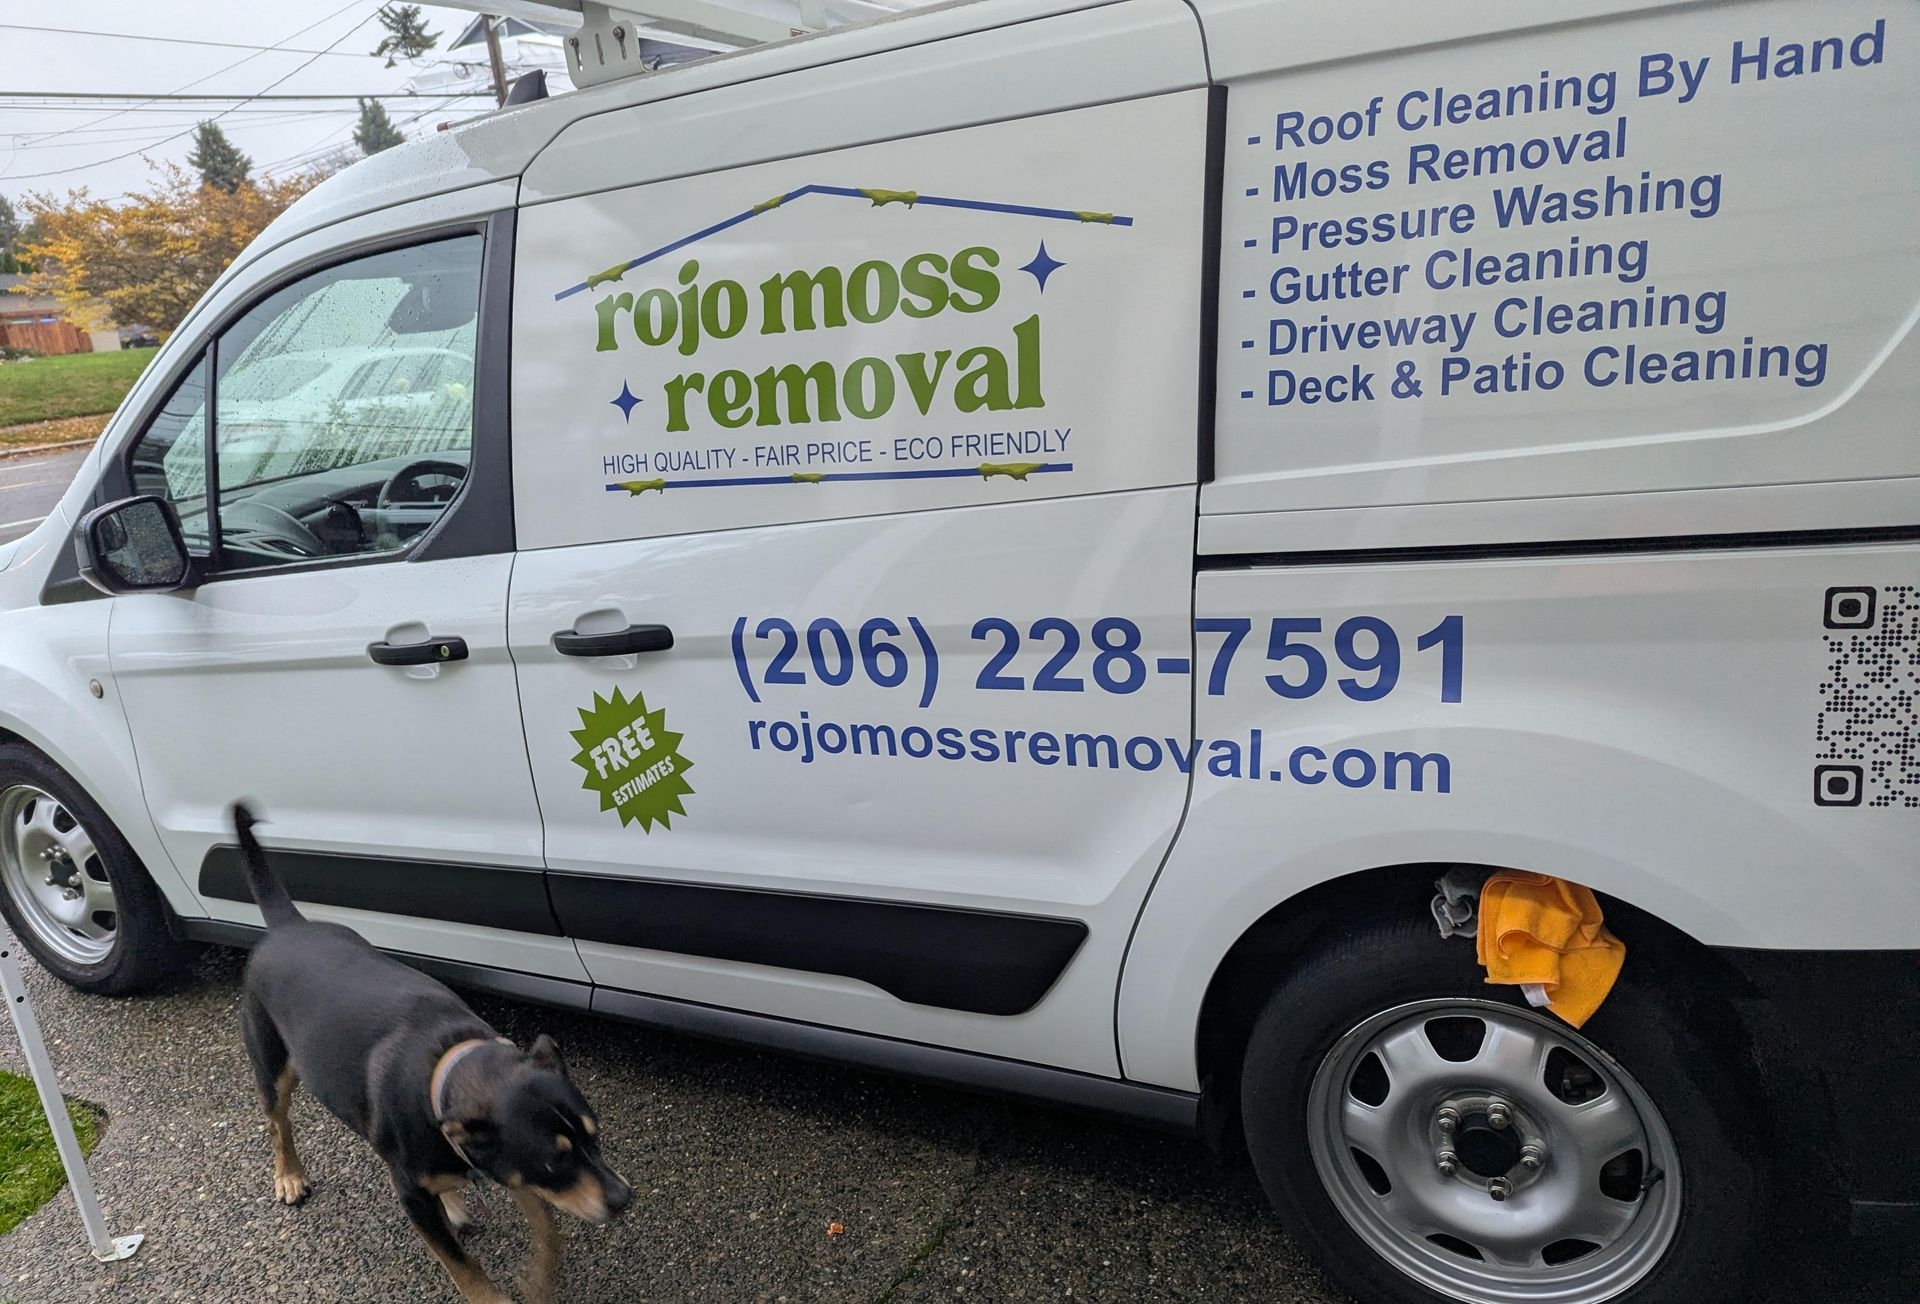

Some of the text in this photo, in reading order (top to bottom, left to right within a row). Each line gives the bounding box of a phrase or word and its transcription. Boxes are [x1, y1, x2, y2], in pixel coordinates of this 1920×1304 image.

[1246, 19, 1886, 150] - Roof Cleaning By Hand
[1245, 116, 1628, 203] - Moss Removal
[1243, 173, 1723, 255] - Pressure Washing
[594, 246, 1001, 356] rojo moss
[1242, 235, 1649, 306] - Gutter Cleaning
[1241, 285, 1728, 356] - Driveway Cleaning
[663, 313, 1046, 433] removal
[1240, 337, 1829, 406] - Deck & Patio Cleaning
[602, 453, 649, 475] HIGH
[653, 448, 737, 473] QUALITY
[754, 444, 802, 468] FAIR
[807, 440, 874, 465] PRICE
[893, 436, 944, 461] ECO
[951, 428, 1073, 459] FRIENDLY
[731, 615, 1464, 709] (206) 228-7591
[589, 715, 657, 781] FREE
[611, 755, 676, 807] ESTIMATES
[748, 711, 1452, 795] rojomossremoval.com
